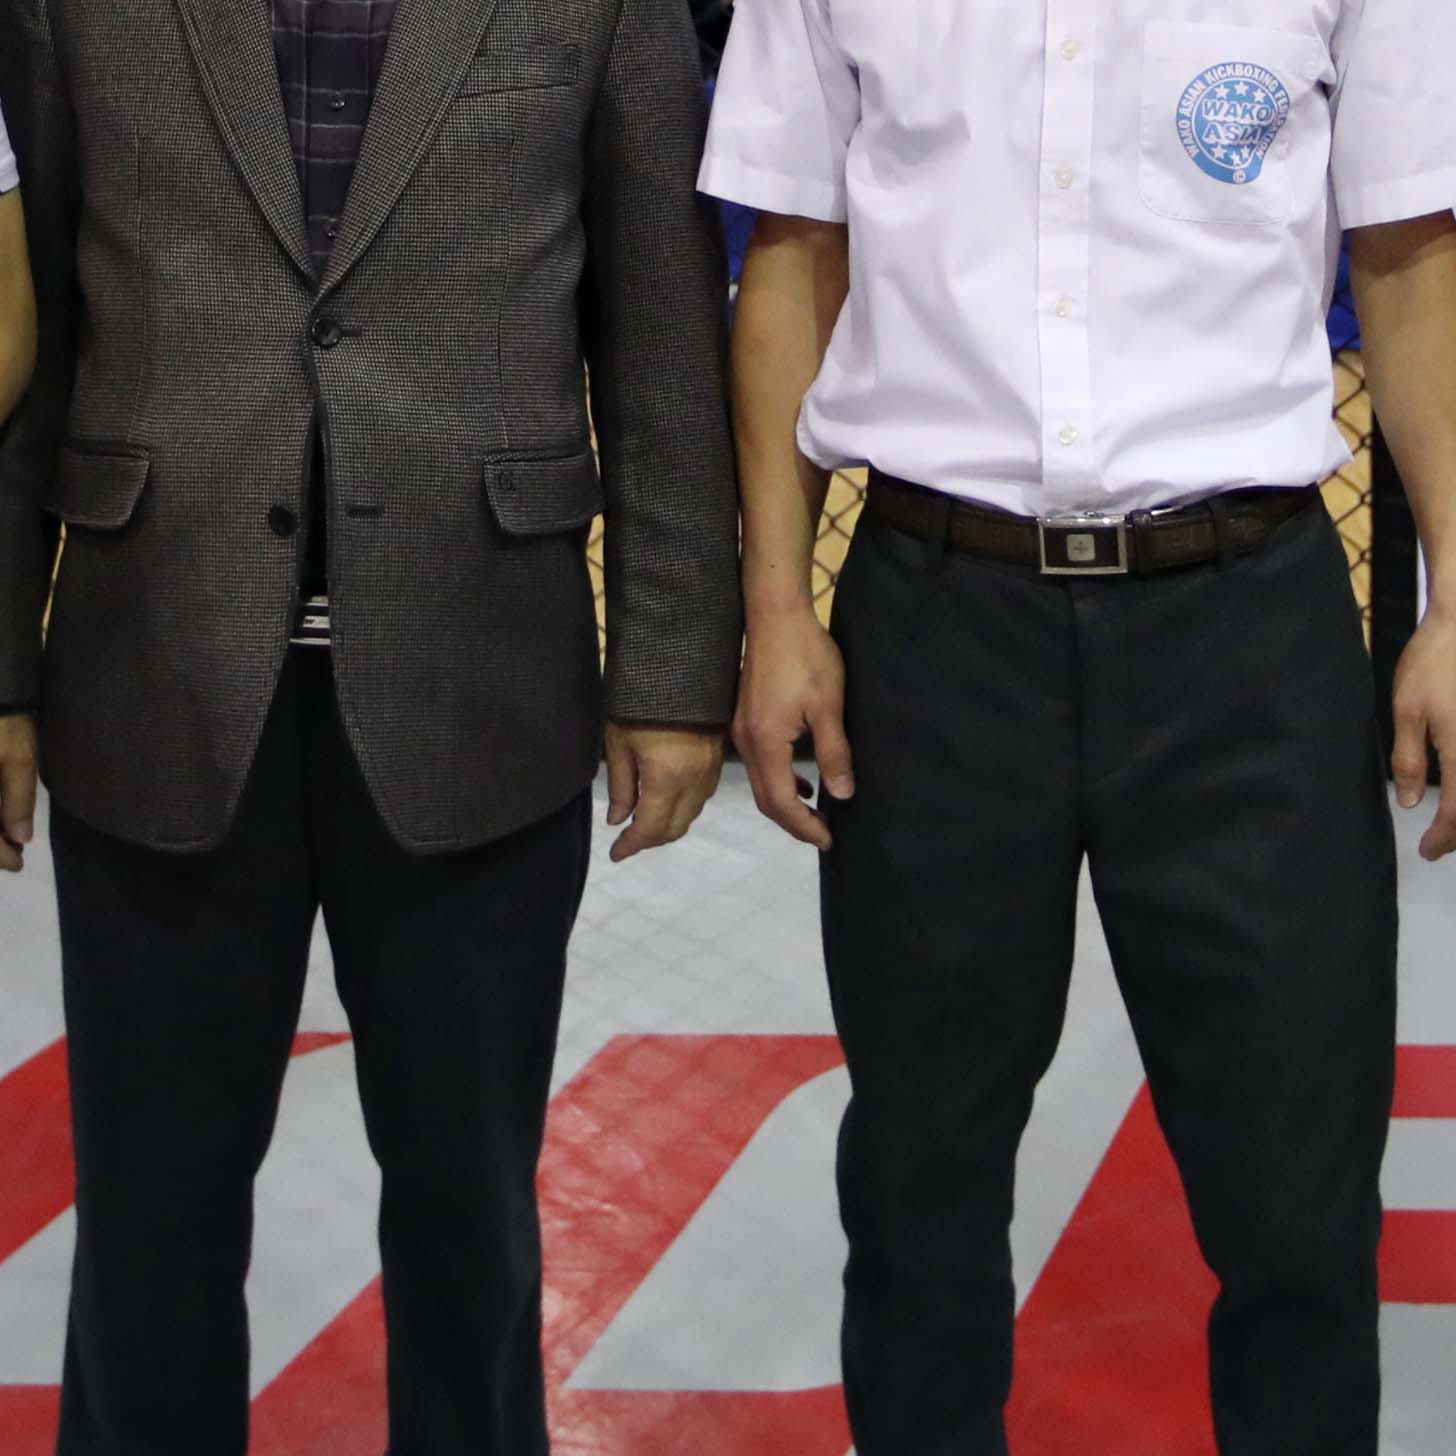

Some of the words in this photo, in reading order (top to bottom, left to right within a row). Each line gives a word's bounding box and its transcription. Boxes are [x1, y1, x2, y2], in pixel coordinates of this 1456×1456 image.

[1178, 79, 1207, 117] ASIAN
[1204, 63, 1279, 93] KICKBOXING
[1202, 99, 1274, 124] WAKO
